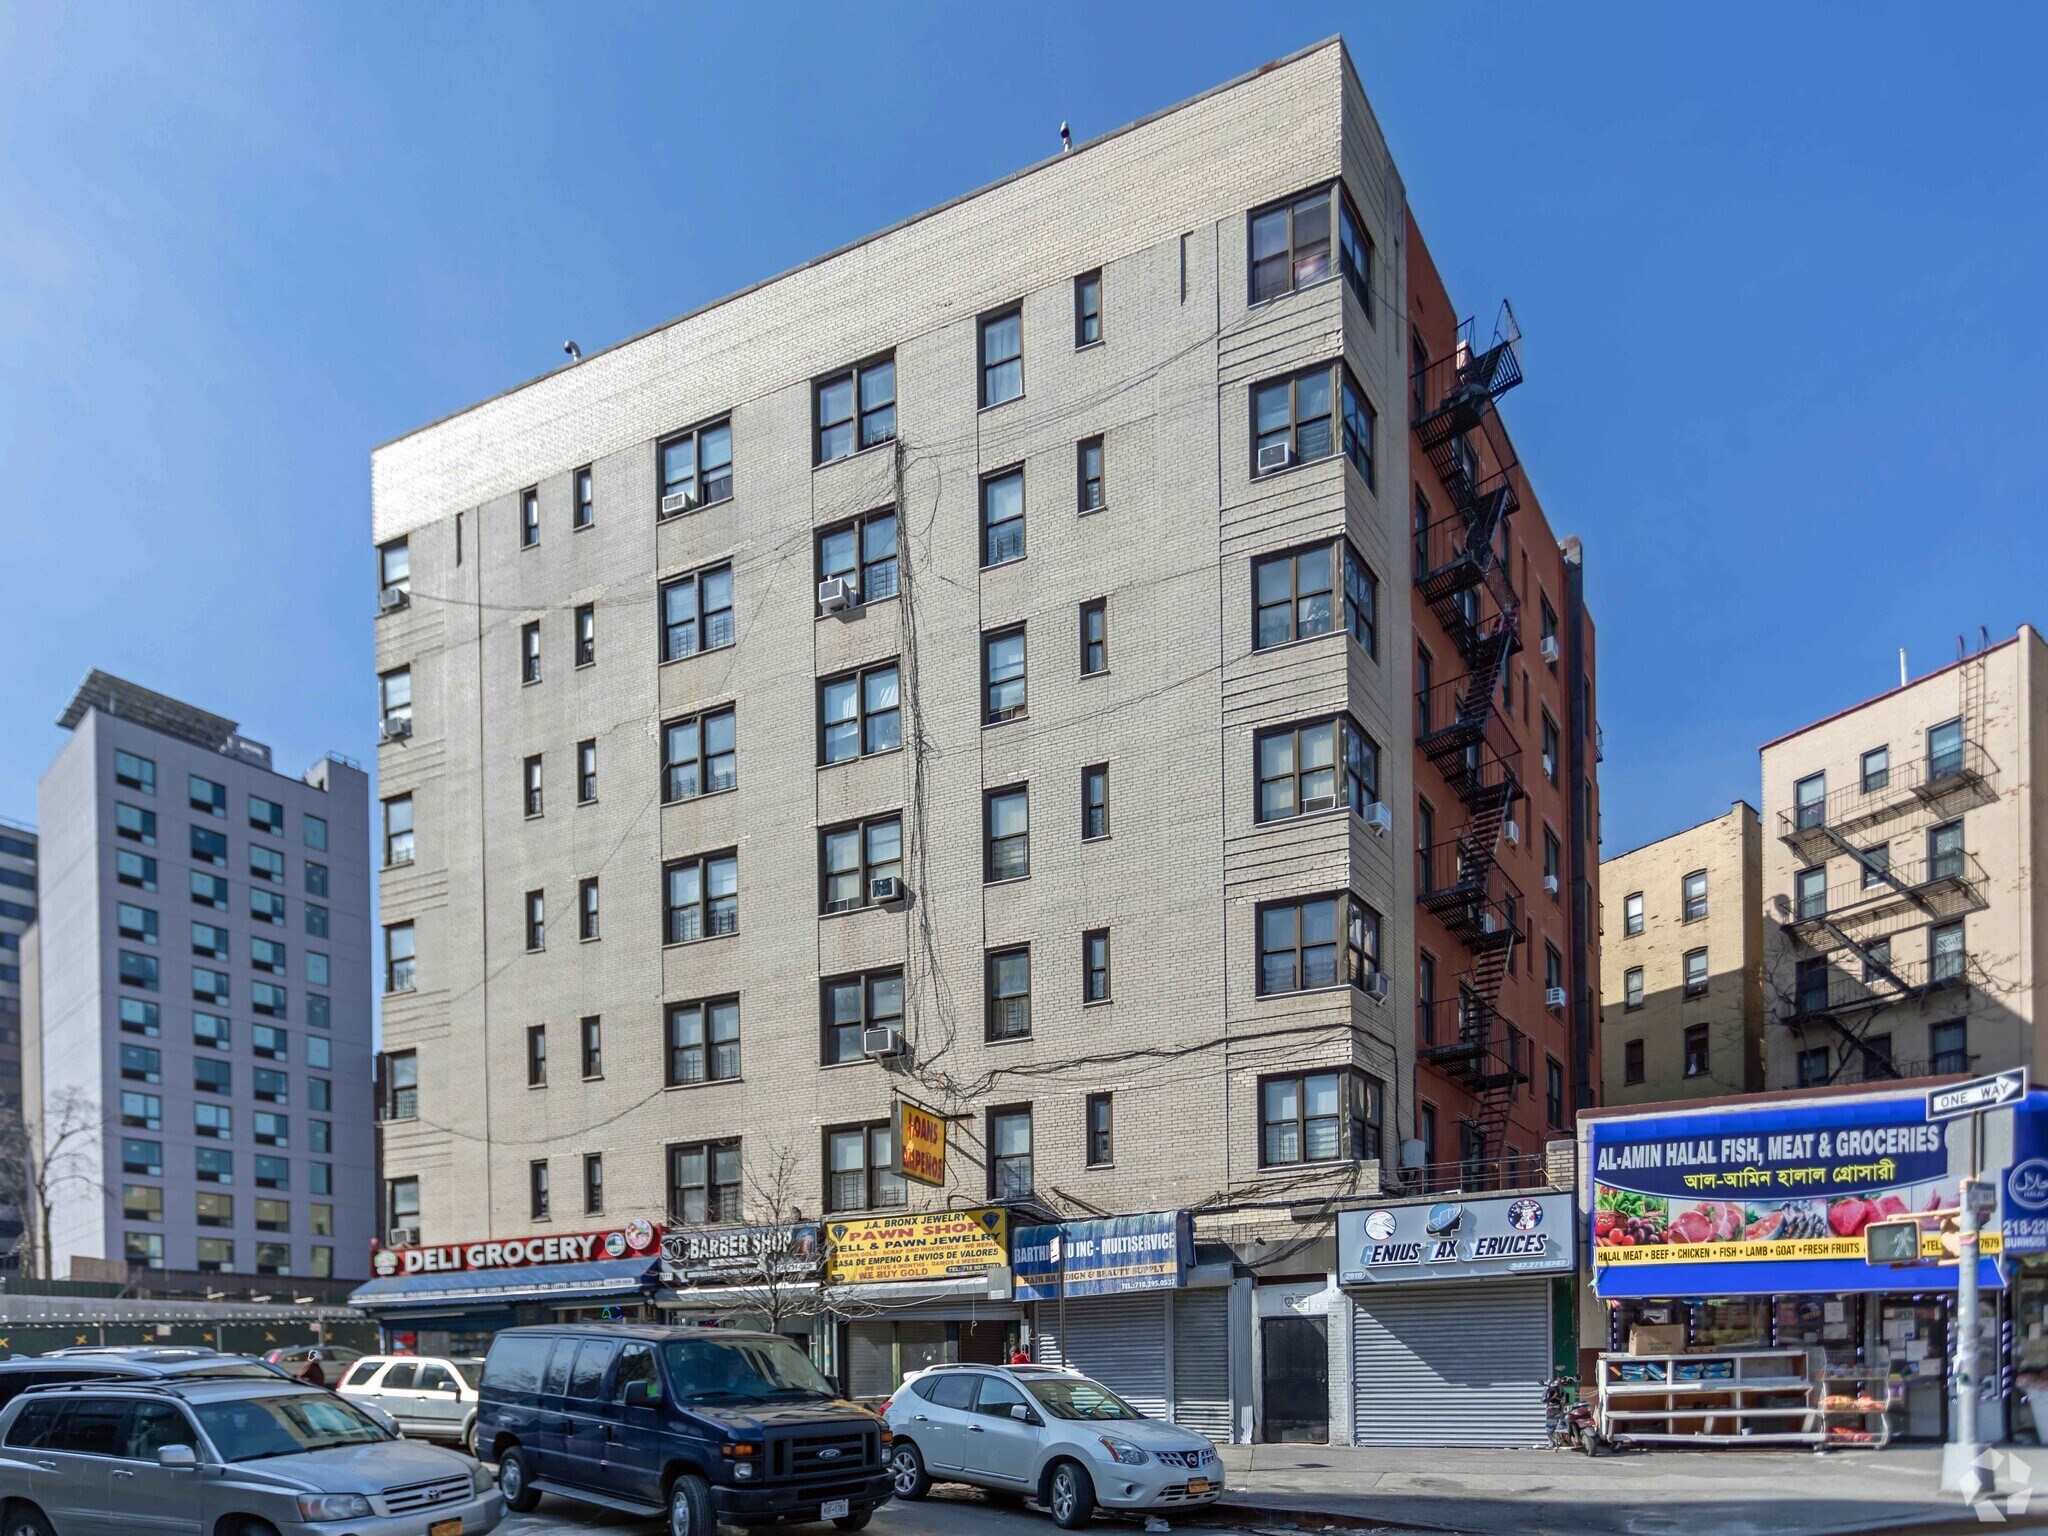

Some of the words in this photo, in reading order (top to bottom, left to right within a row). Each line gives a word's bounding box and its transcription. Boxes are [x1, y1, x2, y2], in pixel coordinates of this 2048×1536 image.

[1941, 1092, 1968, 1108] ONE
[1981, 1083, 2009, 1099] WAY
[1597, 1143, 1661, 1171] AL-AMIN
[1665, 1139, 1717, 1167] HALAL
[1721, 1136, 1763, 1167] FISH,
[1767, 1133, 1814, 1161] MEAT
[1818, 1131, 1832, 1158] &
[1836, 1125, 1939, 1157] GROCERIES
[1683, 1166, 1771, 1190] আল-আমিন
[1776, 1166, 1826, 1187] হালাল
[864, 1221, 881, 1229] J.A.
[884, 1217, 918, 1228] BRONX
[921, 1212, 968, 1224] JEWELRY
[831, 1244, 864, 1253] SELL
[870, 1242, 879, 1250] &
[885, 1238, 926, 1249] PAWN
[930, 1231, 1001, 1245] JEWELRY
[849, 1227, 914, 1242] PAWN
[922, 1221, 981, 1236] SHOP
[2004, 1236, 2047, 1248] BURNSIDE
[404, 1246, 461, 1273] DELI
[466, 1234, 598, 1268] GROCERY
[690, 1234, 749, 1260] BARBER
[751, 1231, 792, 1254] SHOP
[920, 1244, 959, 1252] INSERVIBLE
[1076, 1241, 1094, 1257] INC
[1102, 1231, 1175, 1256] MULTISERVICE
[1360, 1243, 1422, 1267] GENIUS
[1424, 1239, 1460, 1264] TAX
[1462, 1233, 1549, 1262] SERVICES
[1598, 1250, 1621, 1262] HALAL
[1623, 1250, 1643, 1261] MEAT
[1651, 1249, 1669, 1260] BEEF
[1677, 1247, 1710, 1259] CHICKEN
[1719, 1246, 1737, 1257] FISH
[1745, 1246, 1768, 1257] LAMB
[1776, 1245, 1796, 1256] GOAT
[1803, 1244, 1829, 1255] FRESH
[1831, 1242, 1860, 1254] FRUITS
[833, 1259, 853, 1268] CASA
[913, 1252, 944, 1261] ENVIOS
[946, 1251, 958, 1259] DE
[960, 1248, 999, 1258] VALORES
[898, 1261, 925, 1269] MONTHS
[859, 1272, 874, 1280] WE
[876, 1270, 898, 1278] BUY
[900, 1268, 928, 1277] GOLD
[1024, 1274, 1045, 1285] HAIR
[1088, 1270, 1096, 1279] &
[1097, 1267, 1132, 1279] BEAUTY
[1133, 1264, 1165, 1274] SUPPLY
